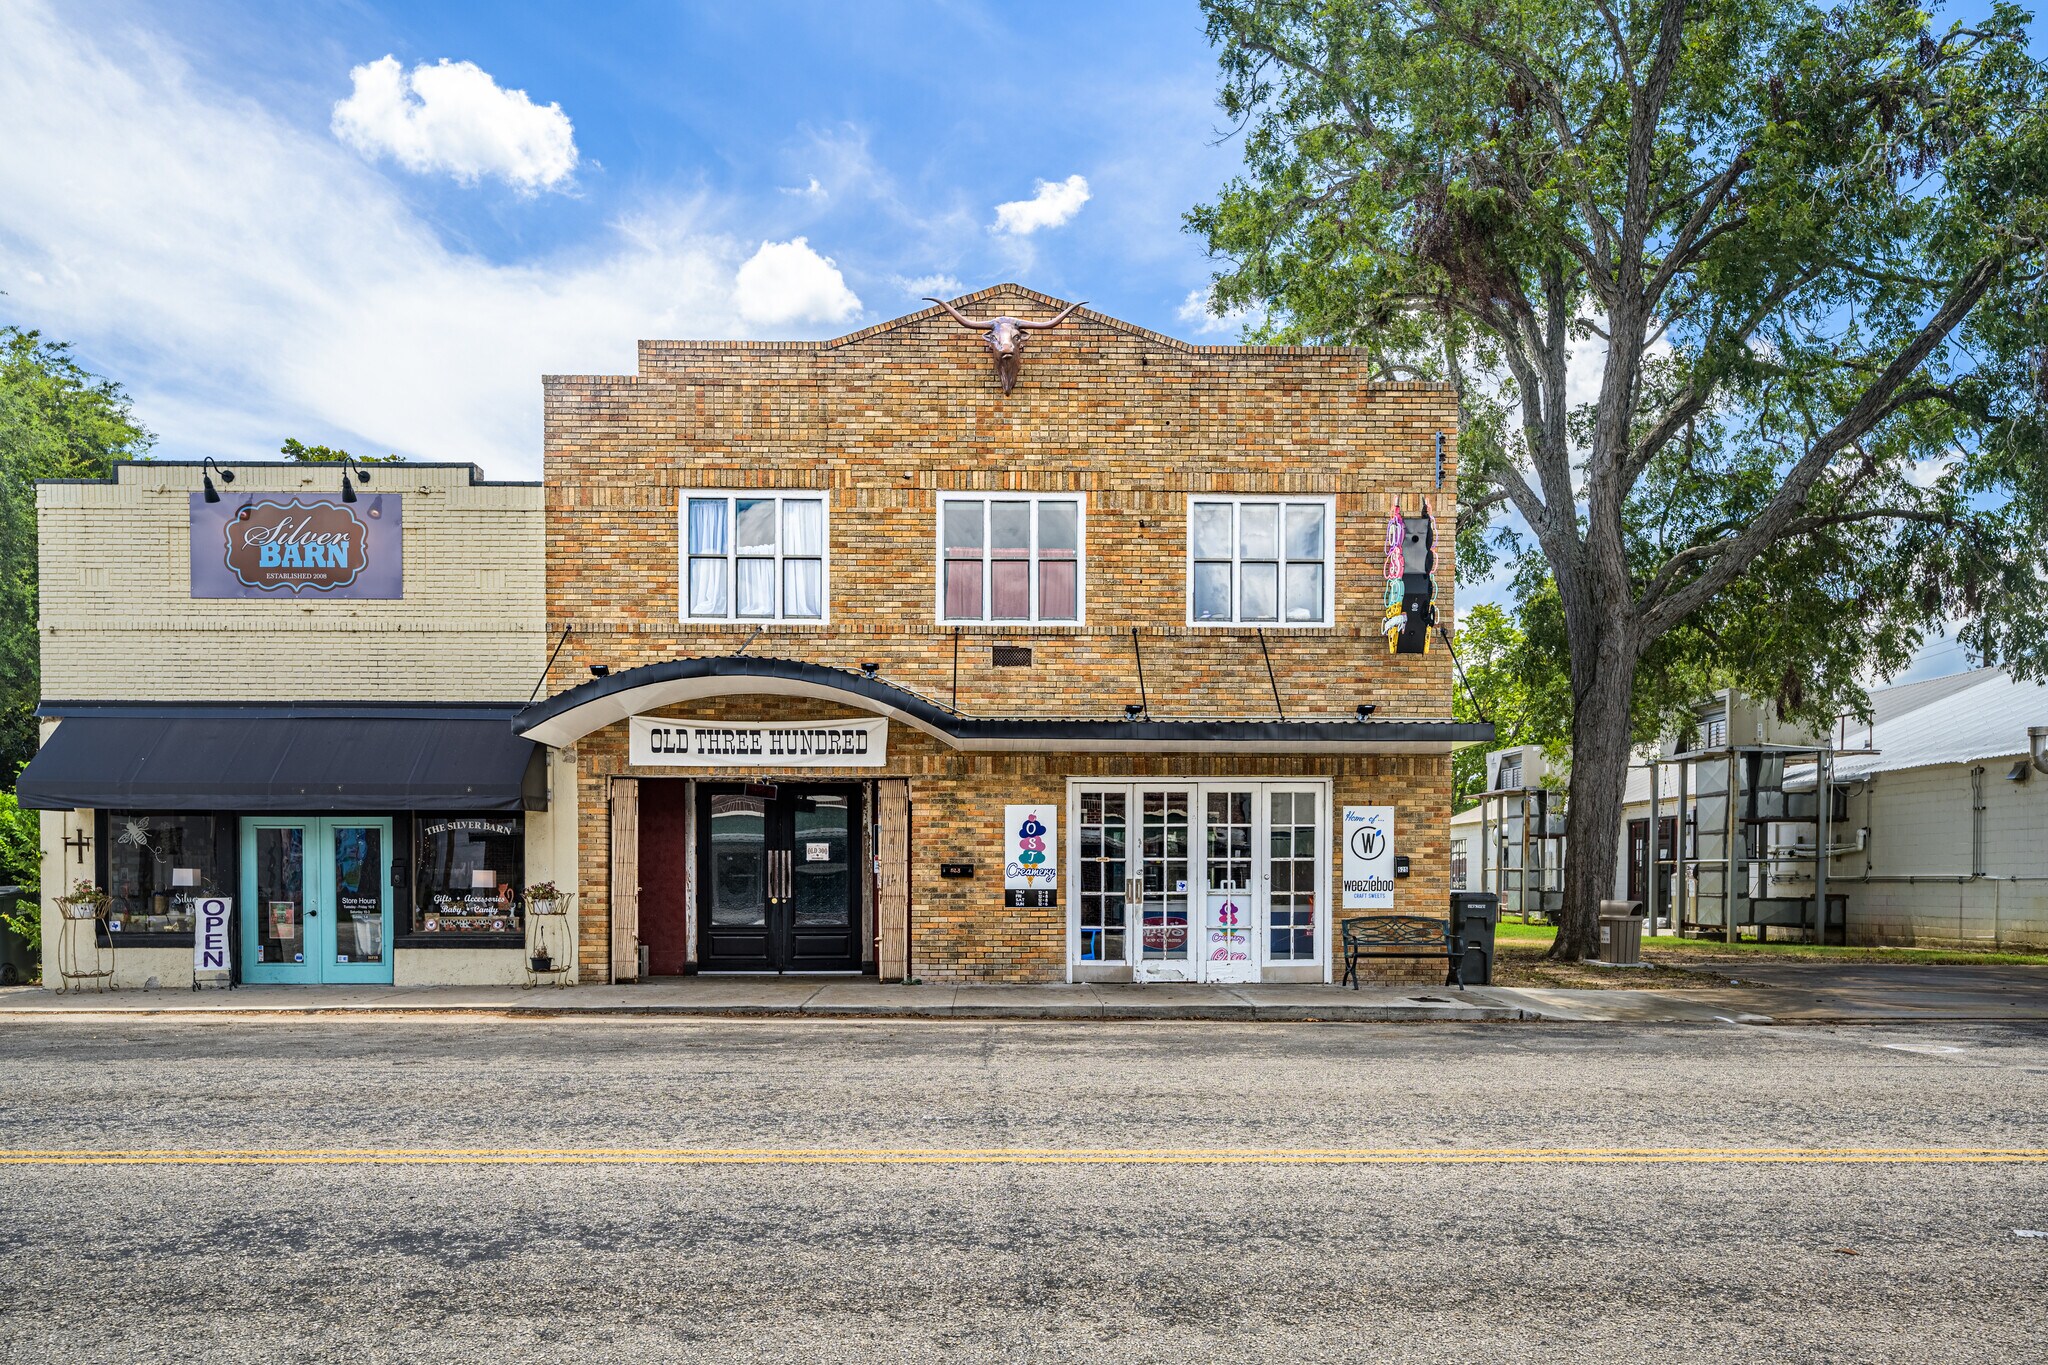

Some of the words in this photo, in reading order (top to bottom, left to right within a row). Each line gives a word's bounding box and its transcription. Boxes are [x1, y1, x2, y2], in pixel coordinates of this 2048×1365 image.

[242, 516, 350, 550] Silver
[259, 540, 350, 568] BARN
[651, 729, 688, 753] OLD
[695, 729, 762, 754] THREE
[769, 730, 868, 754] HUNDRED
[1344, 811, 1365, 822] Home
[424, 823, 446, 835] THE
[447, 821, 481, 830] SILVER
[483, 822, 512, 835] BARN
[1362, 833, 1376, 853] W
[1006, 862, 1055, 882] Creamery
[1344, 876, 1394, 891] weezieboo
[433, 894, 452, 904] Gifts
[464, 894, 505, 903] Accessories
[440, 905, 462, 915] Baby
[474, 905, 498, 914] Candy
[203, 900, 225, 967] OPEN
